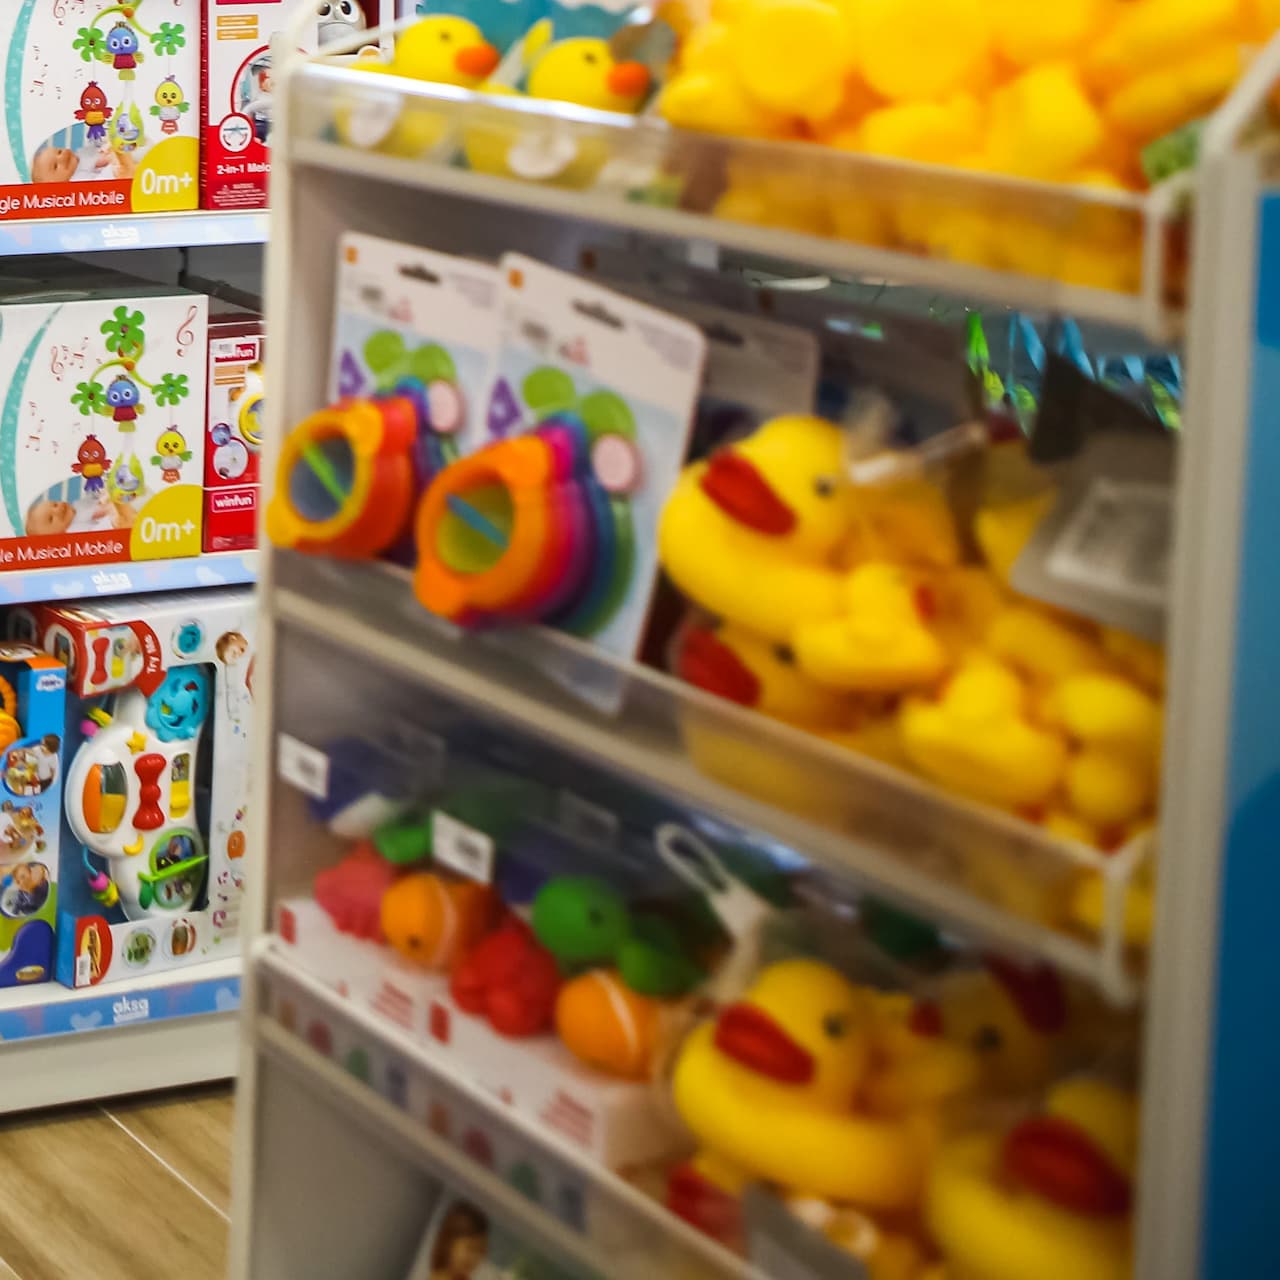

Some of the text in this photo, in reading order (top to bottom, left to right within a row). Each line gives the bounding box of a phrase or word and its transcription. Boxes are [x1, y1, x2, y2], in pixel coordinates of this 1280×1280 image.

[216, 164, 245, 175] 2-in-1
[141, 167, 193, 196] 0m+
[23, 193, 76, 210] Musical
[78, 190, 125, 207] Mobile
[214, 495, 253, 508] winfun
[141, 516, 195, 544] 0m+
[16, 544, 72, 562] Musical
[74, 541, 123, 557] Mobile
[113, 998, 148, 1014] aksa
